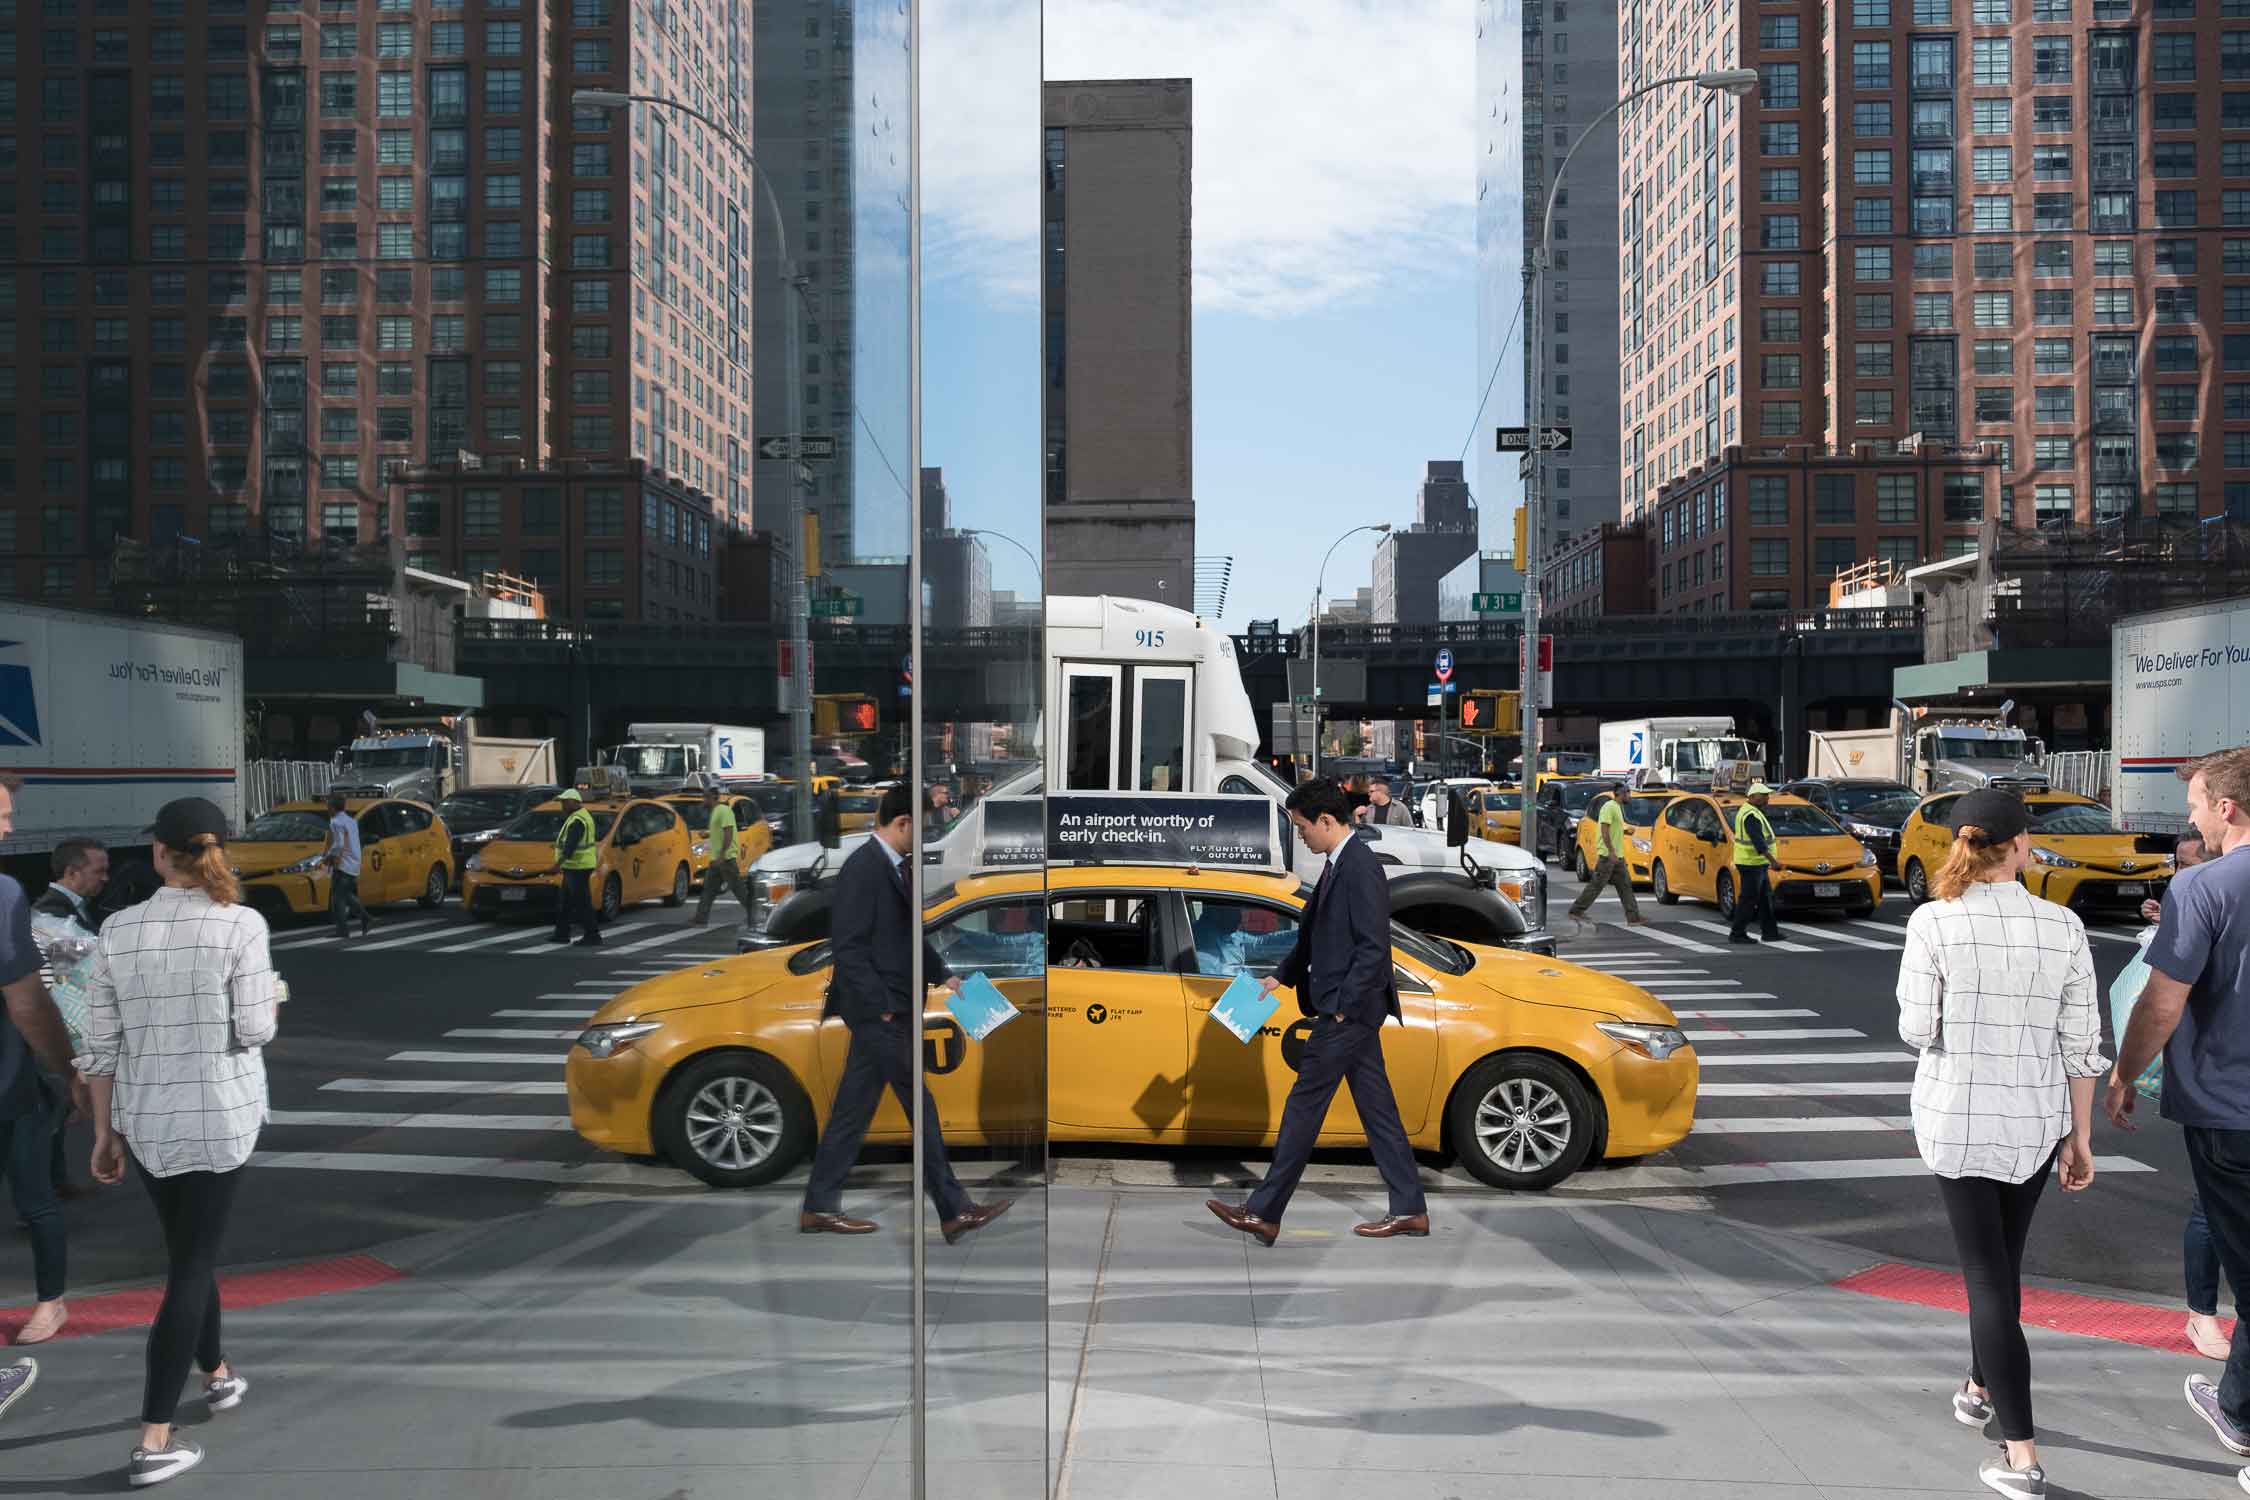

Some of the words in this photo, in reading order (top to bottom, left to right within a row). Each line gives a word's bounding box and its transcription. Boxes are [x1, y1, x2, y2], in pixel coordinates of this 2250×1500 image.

[1507, 433, 1529, 445] ONE
[1480, 595, 1489, 609] W
[1493, 595, 1505, 610] 31
[1135, 629, 1165, 648] 915
[2135, 655, 2154, 673] We
[2155, 651, 2199, 672] Deliver
[2200, 648, 2224, 667] For
[1059, 813, 1081, 826] An
[1085, 813, 1137, 828] airport
[1141, 814, 1195, 832] worthy
[1198, 815, 1215, 828] of
[1059, 829, 1098, 844] early
[1101, 829, 1166, 843] check-in.
